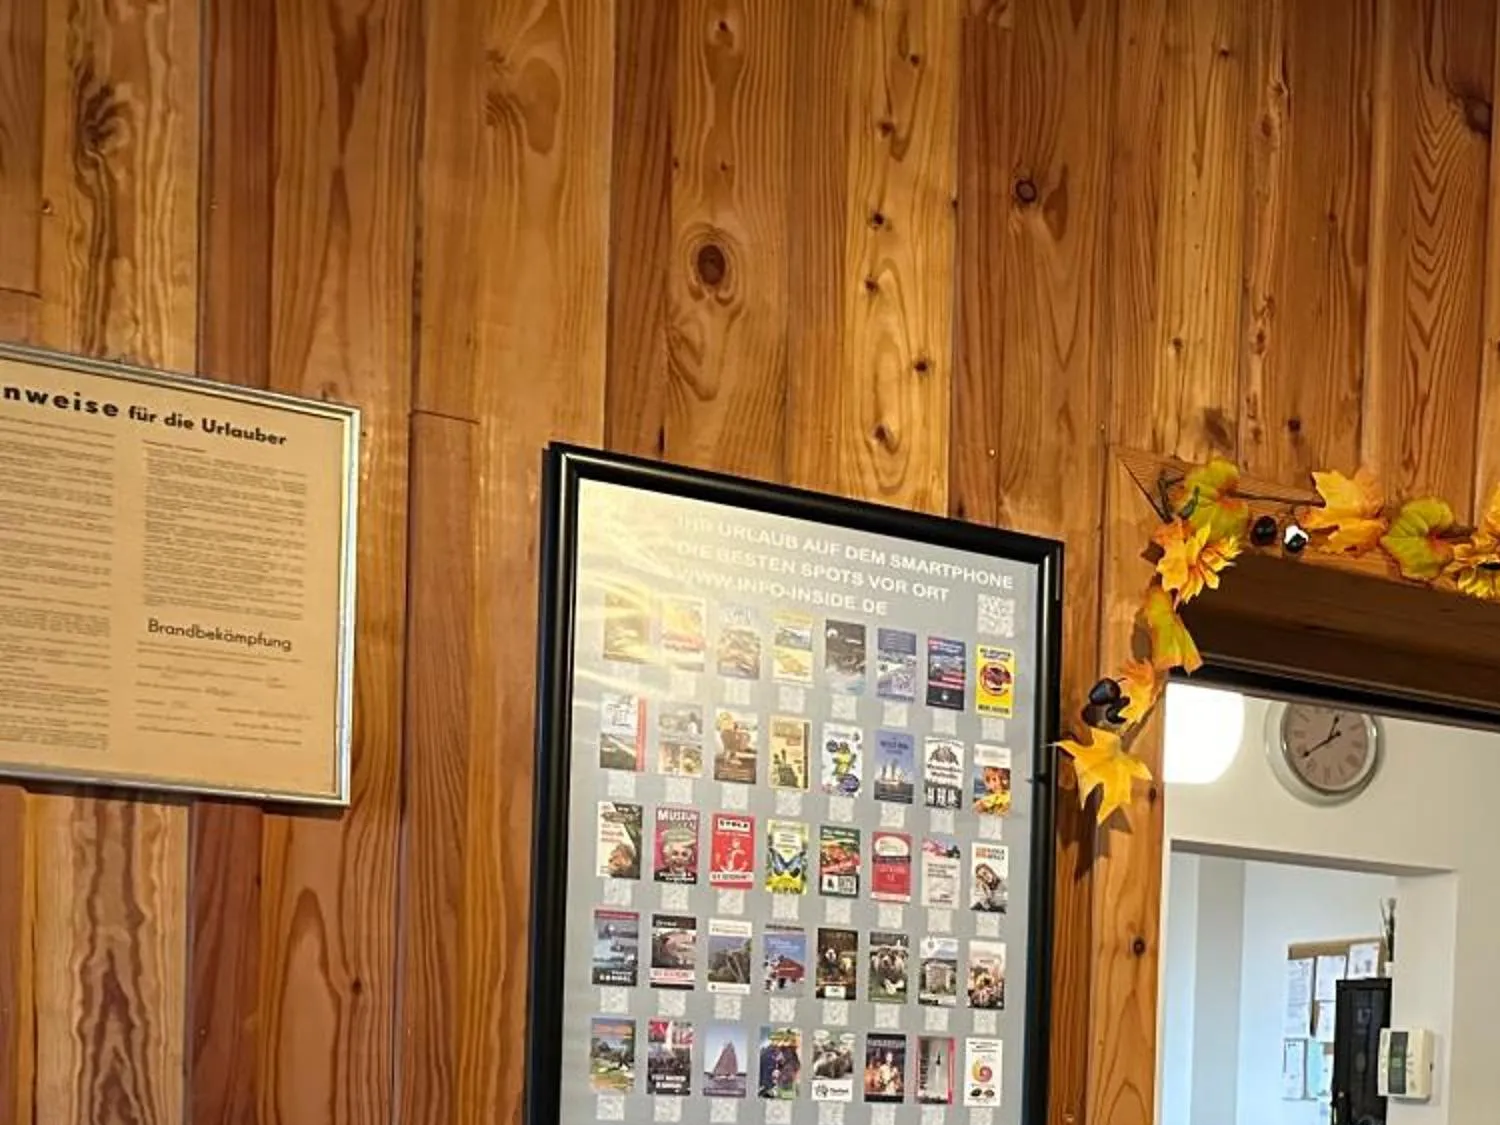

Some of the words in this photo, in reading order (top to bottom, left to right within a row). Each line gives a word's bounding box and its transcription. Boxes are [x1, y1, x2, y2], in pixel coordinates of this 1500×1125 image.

[3, 385, 119, 417] nweise
[129, 405, 156, 423] für
[163, 413, 194, 431] die
[201, 417, 287, 445] Urlauber
[718, 522, 799, 550] URLAUB
[802, 539, 843, 557] AUF
[844, 545, 886, 566] DEM
[889, 553, 1014, 591] SMARTPHONE
[719, 547, 796, 575] BESTEN
[800, 561, 865, 588] SPOTS
[868, 574, 907, 594] VOR
[912, 584, 950, 602] ORT
[148, 618, 292, 653] Brandbekämpfung
